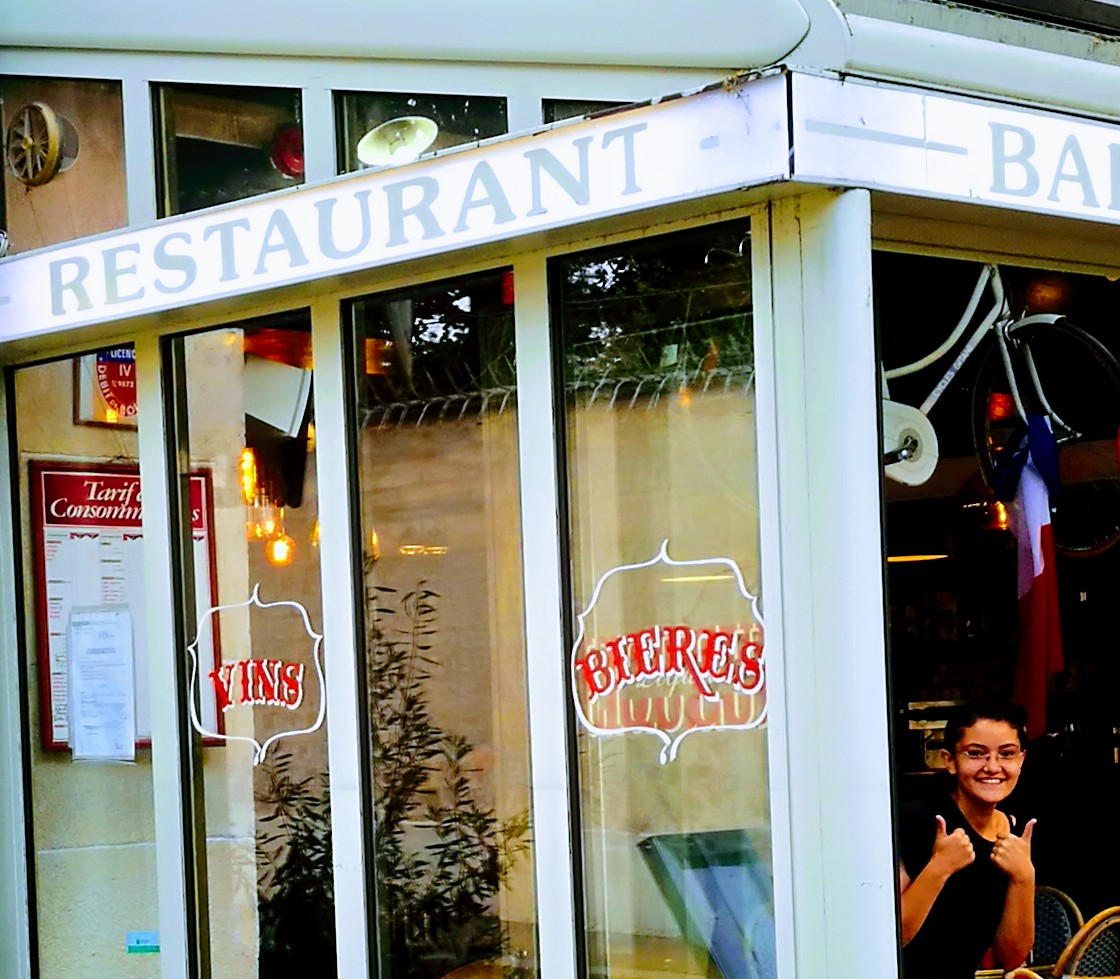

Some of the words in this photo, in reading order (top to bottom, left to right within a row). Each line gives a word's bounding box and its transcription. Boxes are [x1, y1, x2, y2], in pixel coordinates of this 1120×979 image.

[48, 122, 648, 316] RESTAURANT
[84, 480, 140, 506] Tarif
[208, 659, 305, 712] VINS
